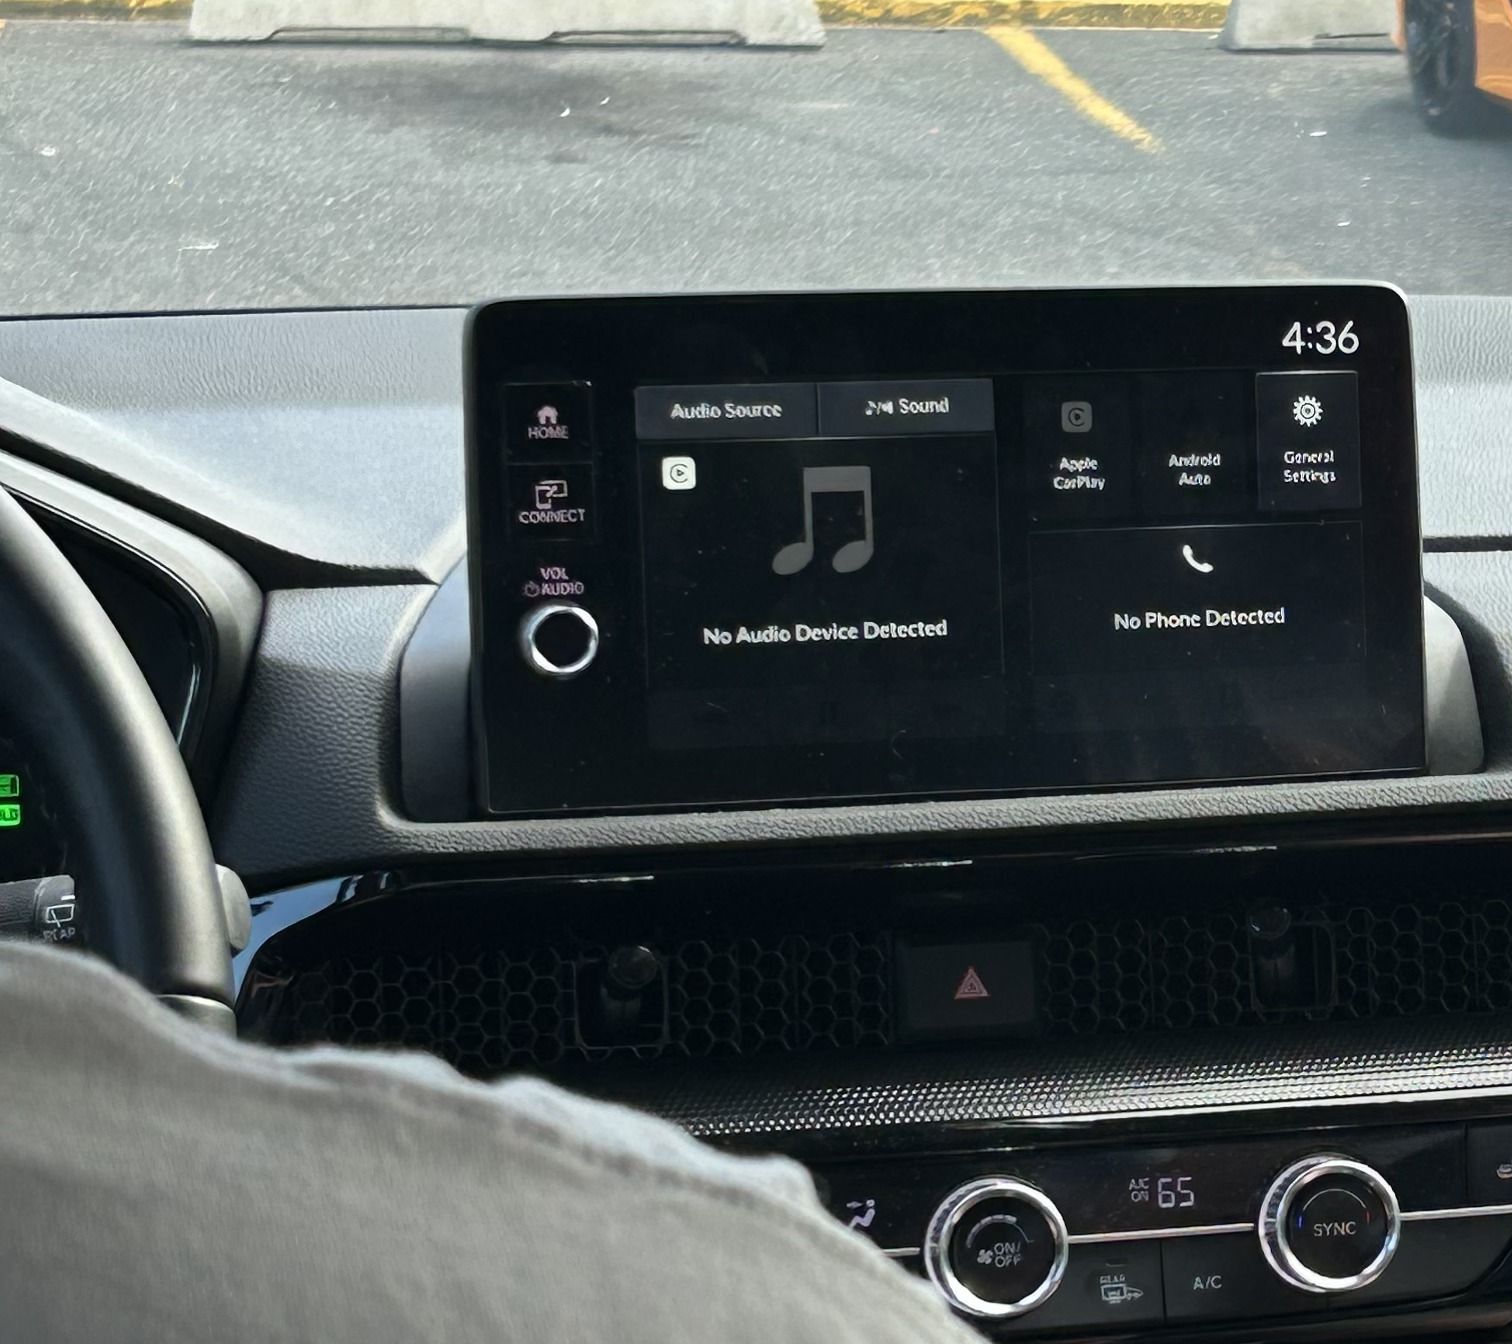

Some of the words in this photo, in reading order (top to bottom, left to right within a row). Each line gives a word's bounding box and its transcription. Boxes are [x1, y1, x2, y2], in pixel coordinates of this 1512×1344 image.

[1282, 320, 1360, 355] 4:36
[670, 402, 721, 419] Audio
[725, 402, 782, 419] Source
[899, 396, 949, 415] Sound
[528, 426, 569, 439] HOME
[1059, 456, 1098, 473] Apple
[1168, 453, 1221, 468] Android
[1284, 450, 1335, 464] General
[1178, 471, 1212, 486] Auto
[1283, 468, 1337, 484] Settings
[519, 508, 586, 524] CONNECT
[540, 566, 569, 580] VOL
[541, 582, 585, 596] AUDIO
[1114, 613, 1141, 630] No
[1145, 611, 1201, 629] Phone
[1205, 607, 1286, 628] Detected
[703, 627, 732, 645] No
[736, 625, 791, 644] Audio
[795, 622, 859, 642] Device
[863, 619, 948, 640] Detected
[1131, 1191, 1149, 1202] ON
[1157, 1176, 1195, 1208] 65
[1313, 1221, 1357, 1237] SYNC
[995, 1256, 1021, 1267] OFF
[1193, 1275, 1223, 1290] A/C
